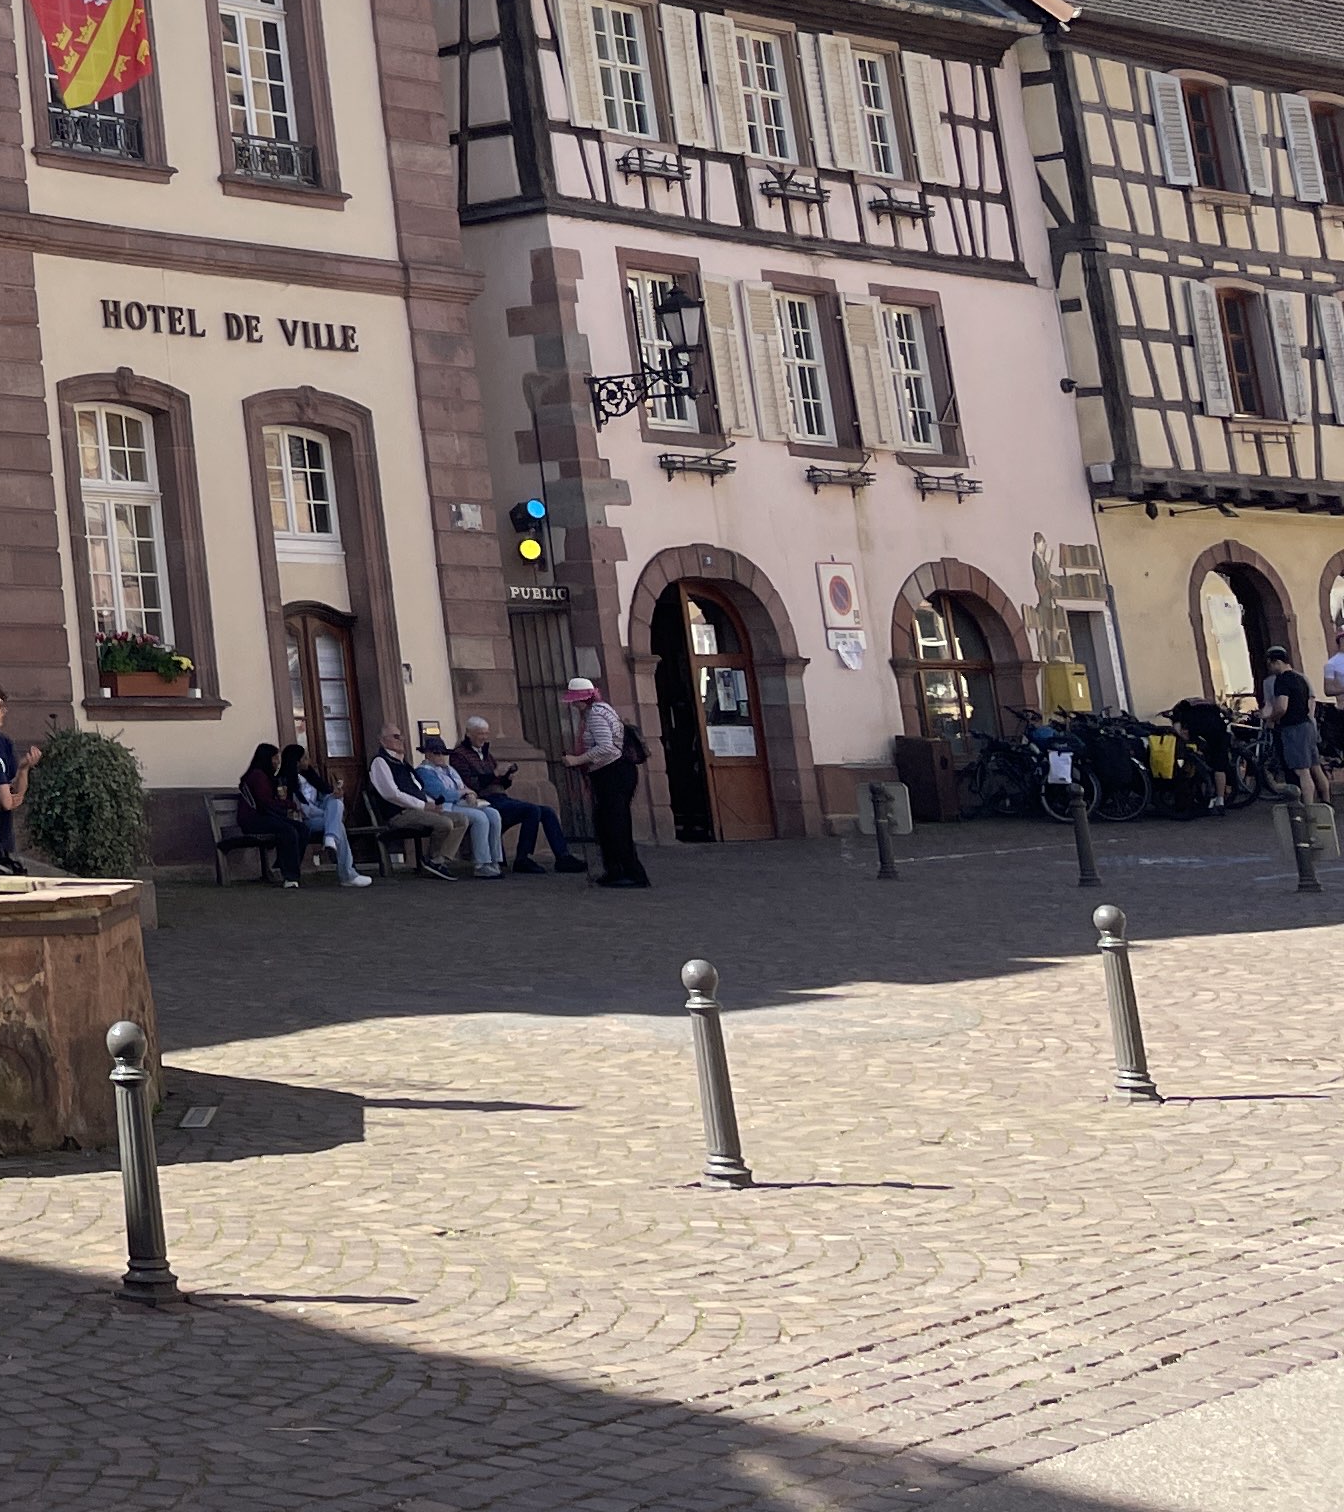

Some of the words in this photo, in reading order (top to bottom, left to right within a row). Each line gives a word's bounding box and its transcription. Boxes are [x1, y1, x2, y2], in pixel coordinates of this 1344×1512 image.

[100, 299, 206, 338] HOTEL
[224, 312, 263, 343] DE
[277, 318, 359, 352] VILLE
[509, 586, 567, 601] PUBLIC
